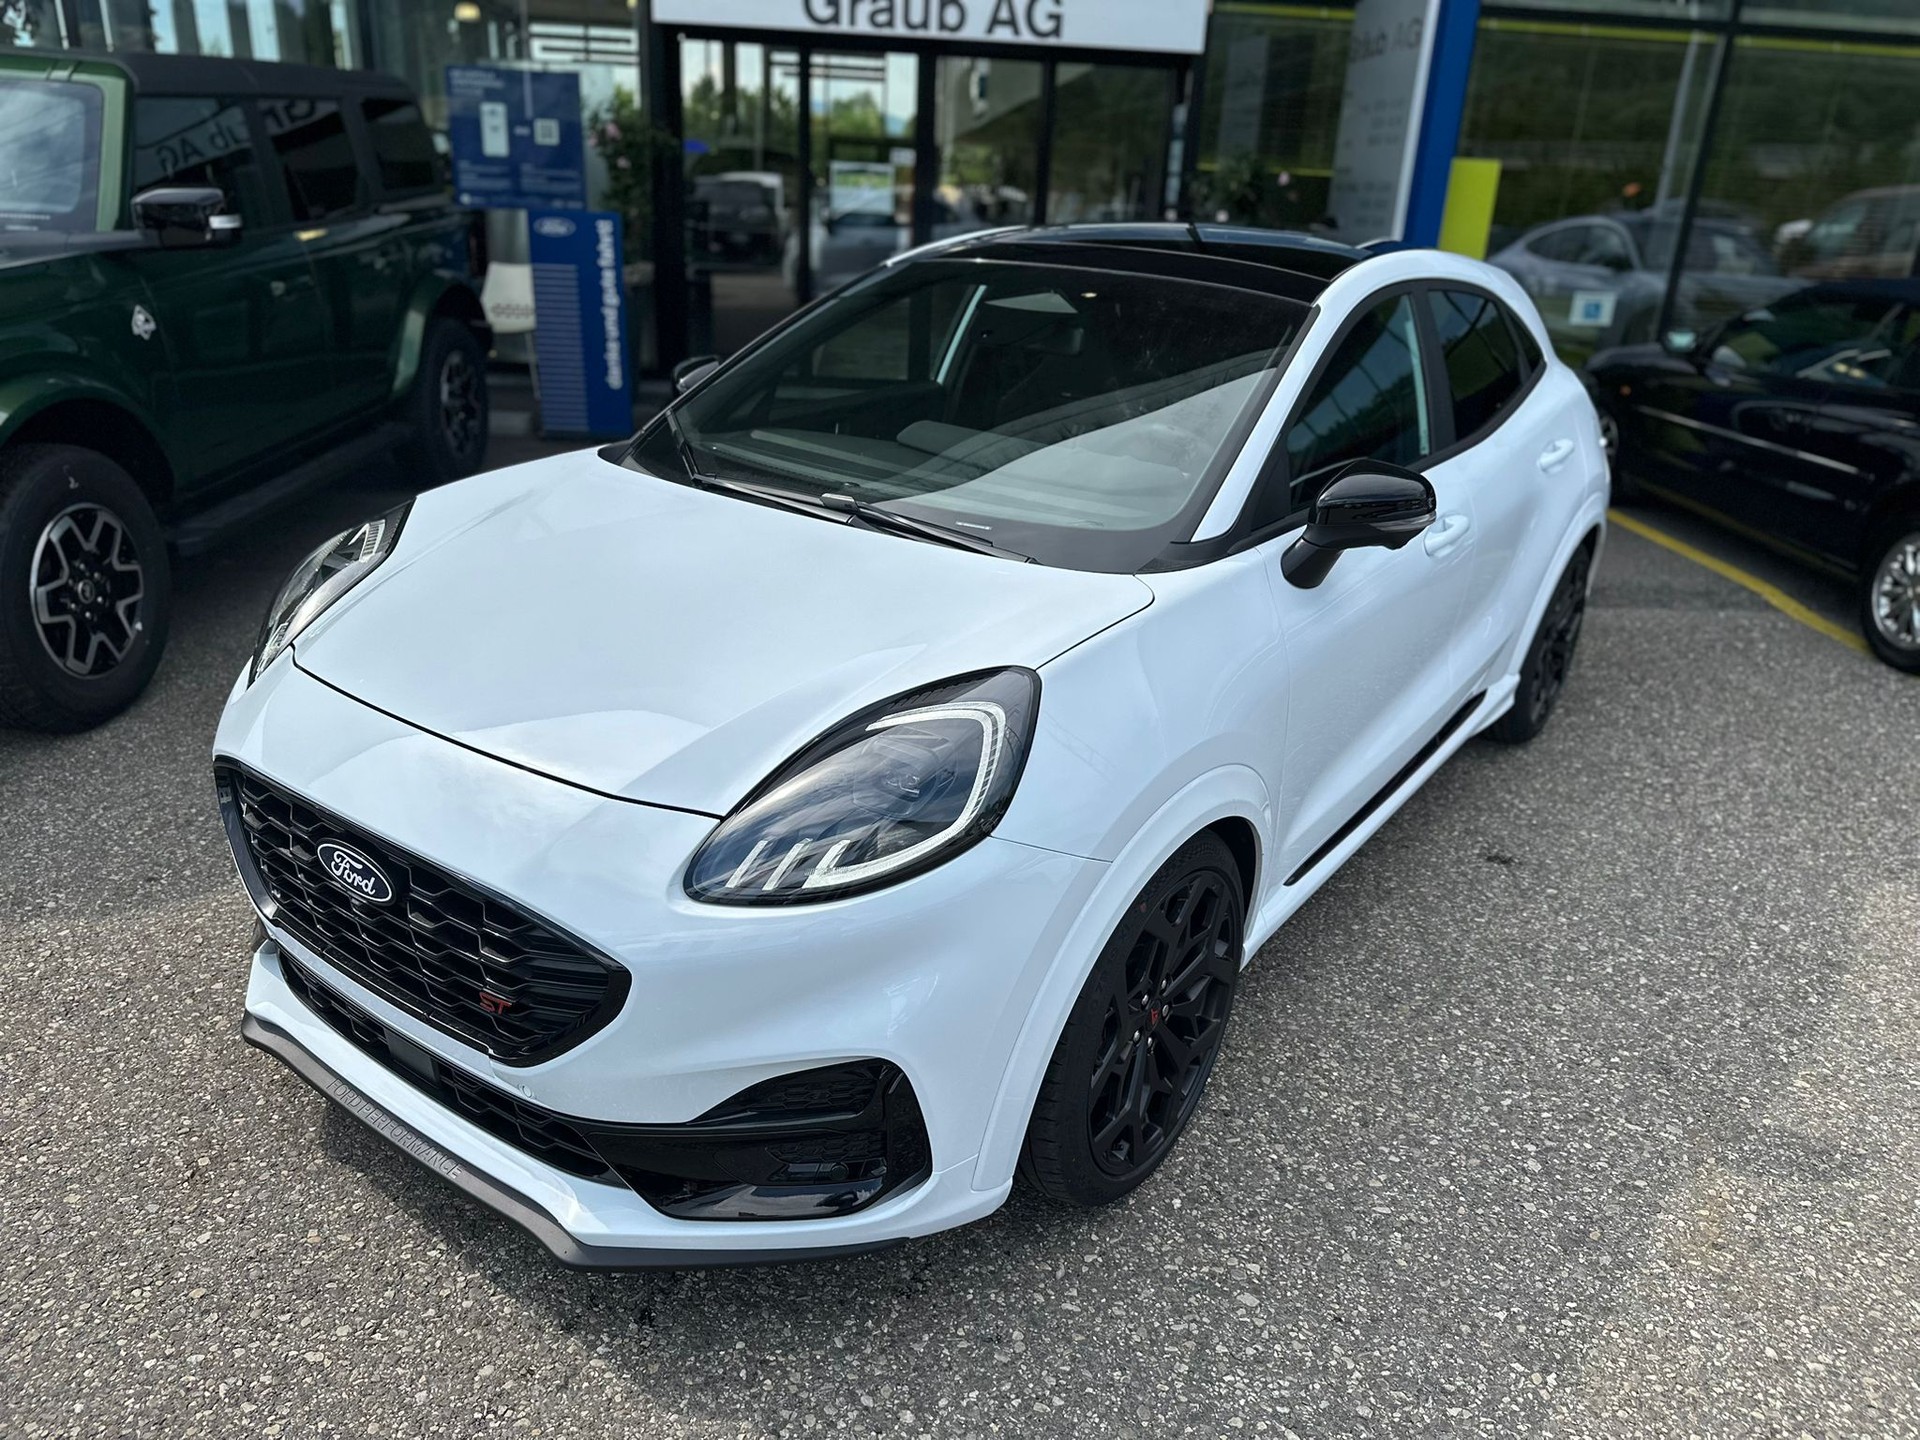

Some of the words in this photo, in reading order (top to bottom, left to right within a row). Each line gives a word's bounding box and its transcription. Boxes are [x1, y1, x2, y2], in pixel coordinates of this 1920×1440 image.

[803, 0, 967, 33] Graub
[985, 0, 1065, 39] AG
[331, 851, 376, 895] Ford
[479, 991, 512, 1016] ST
[326, 1078, 363, 1109] FORD
[357, 1102, 463, 1180] PERFORMANCE
